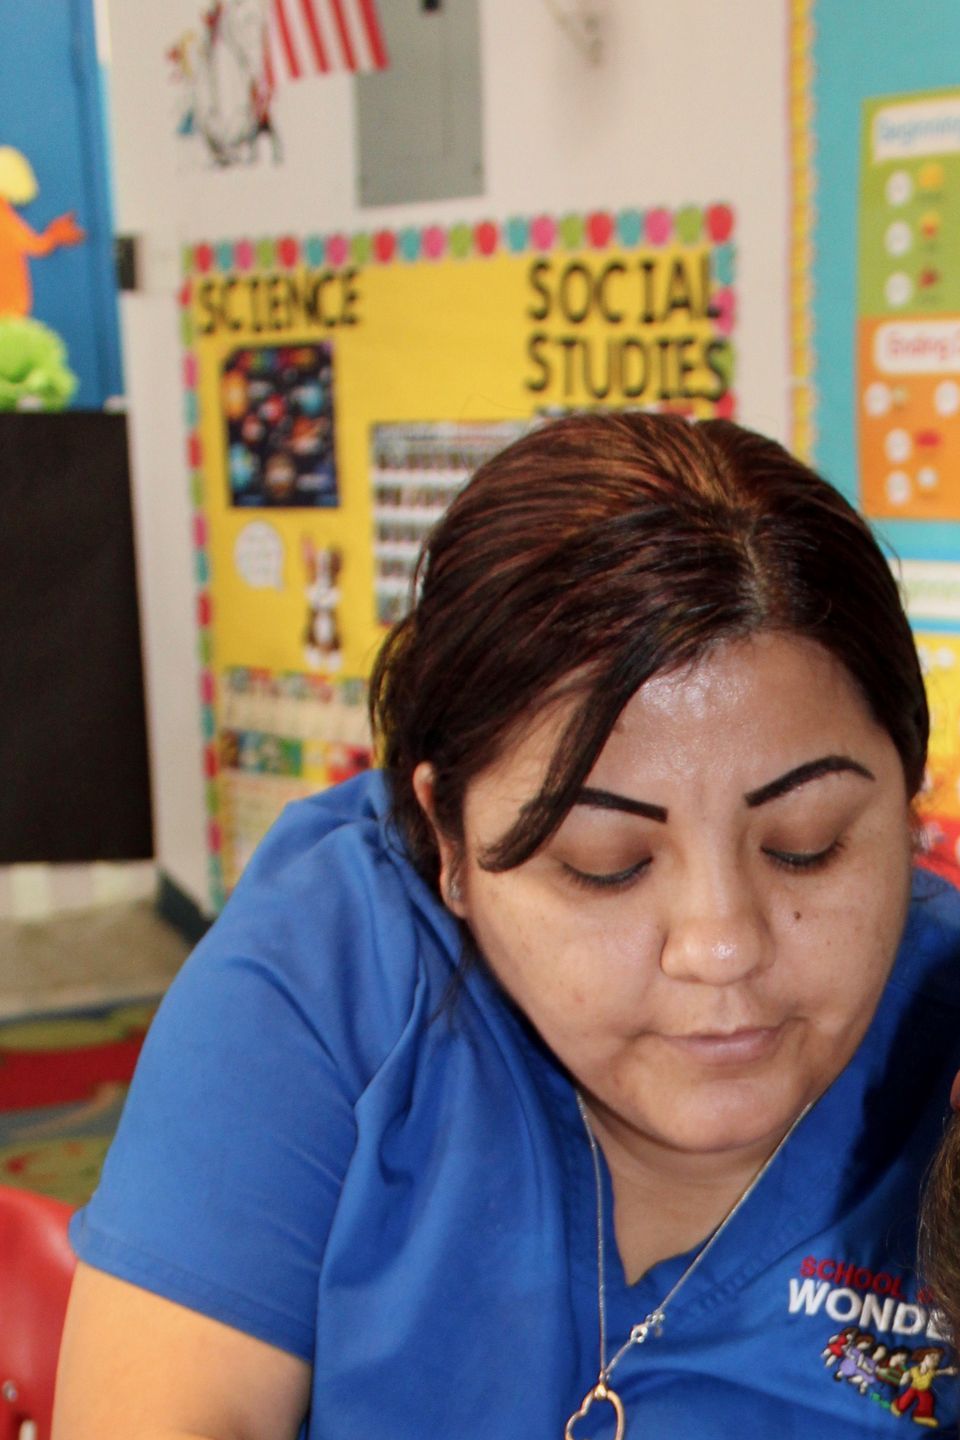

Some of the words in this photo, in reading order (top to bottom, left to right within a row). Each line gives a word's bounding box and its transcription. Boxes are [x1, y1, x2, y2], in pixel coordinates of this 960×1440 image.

[199, 266, 362, 335] SCIENCE
[527, 259, 723, 326] SOCIAL
[525, 332, 731, 401] STUDIES
[800, 1255, 906, 1299] SCHOOL
